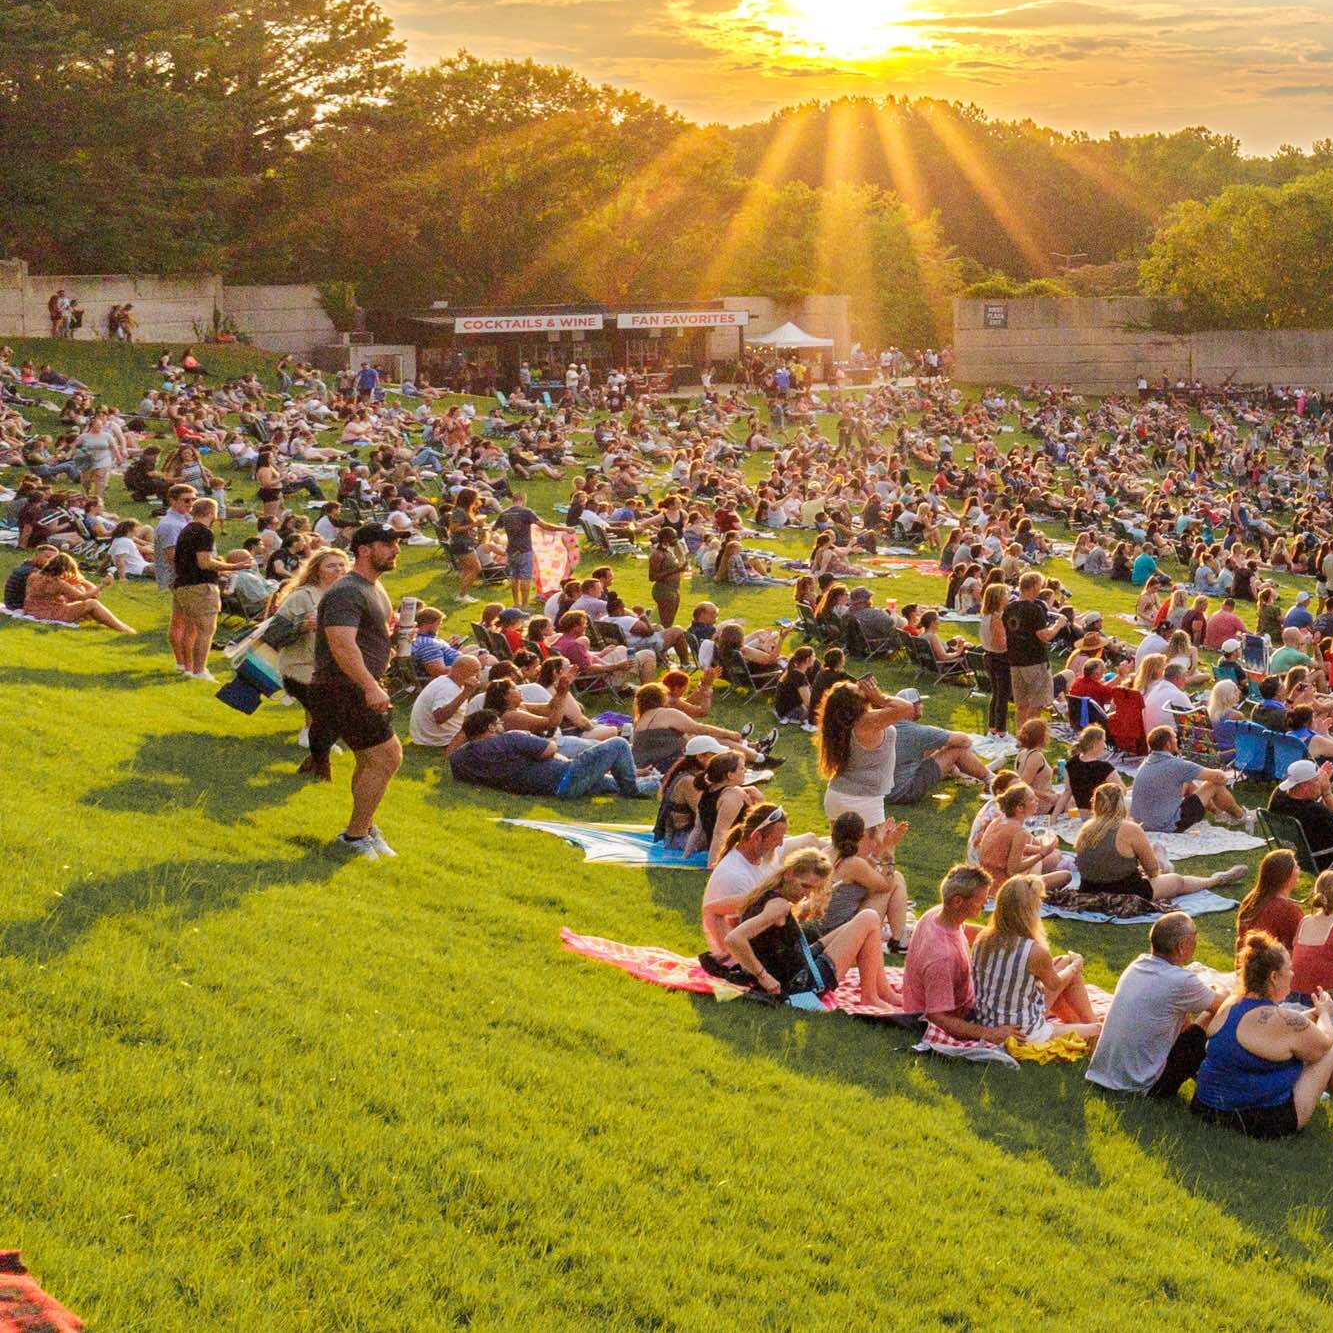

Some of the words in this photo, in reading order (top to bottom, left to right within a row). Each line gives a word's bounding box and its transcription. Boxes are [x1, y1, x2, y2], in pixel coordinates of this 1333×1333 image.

[463, 318, 543, 330] COCKTAILS
[546, 319, 555, 328] &
[560, 317, 596, 328] WINE
[631, 315, 660, 326] FAN
[663, 313, 736, 325] FAVORITES
